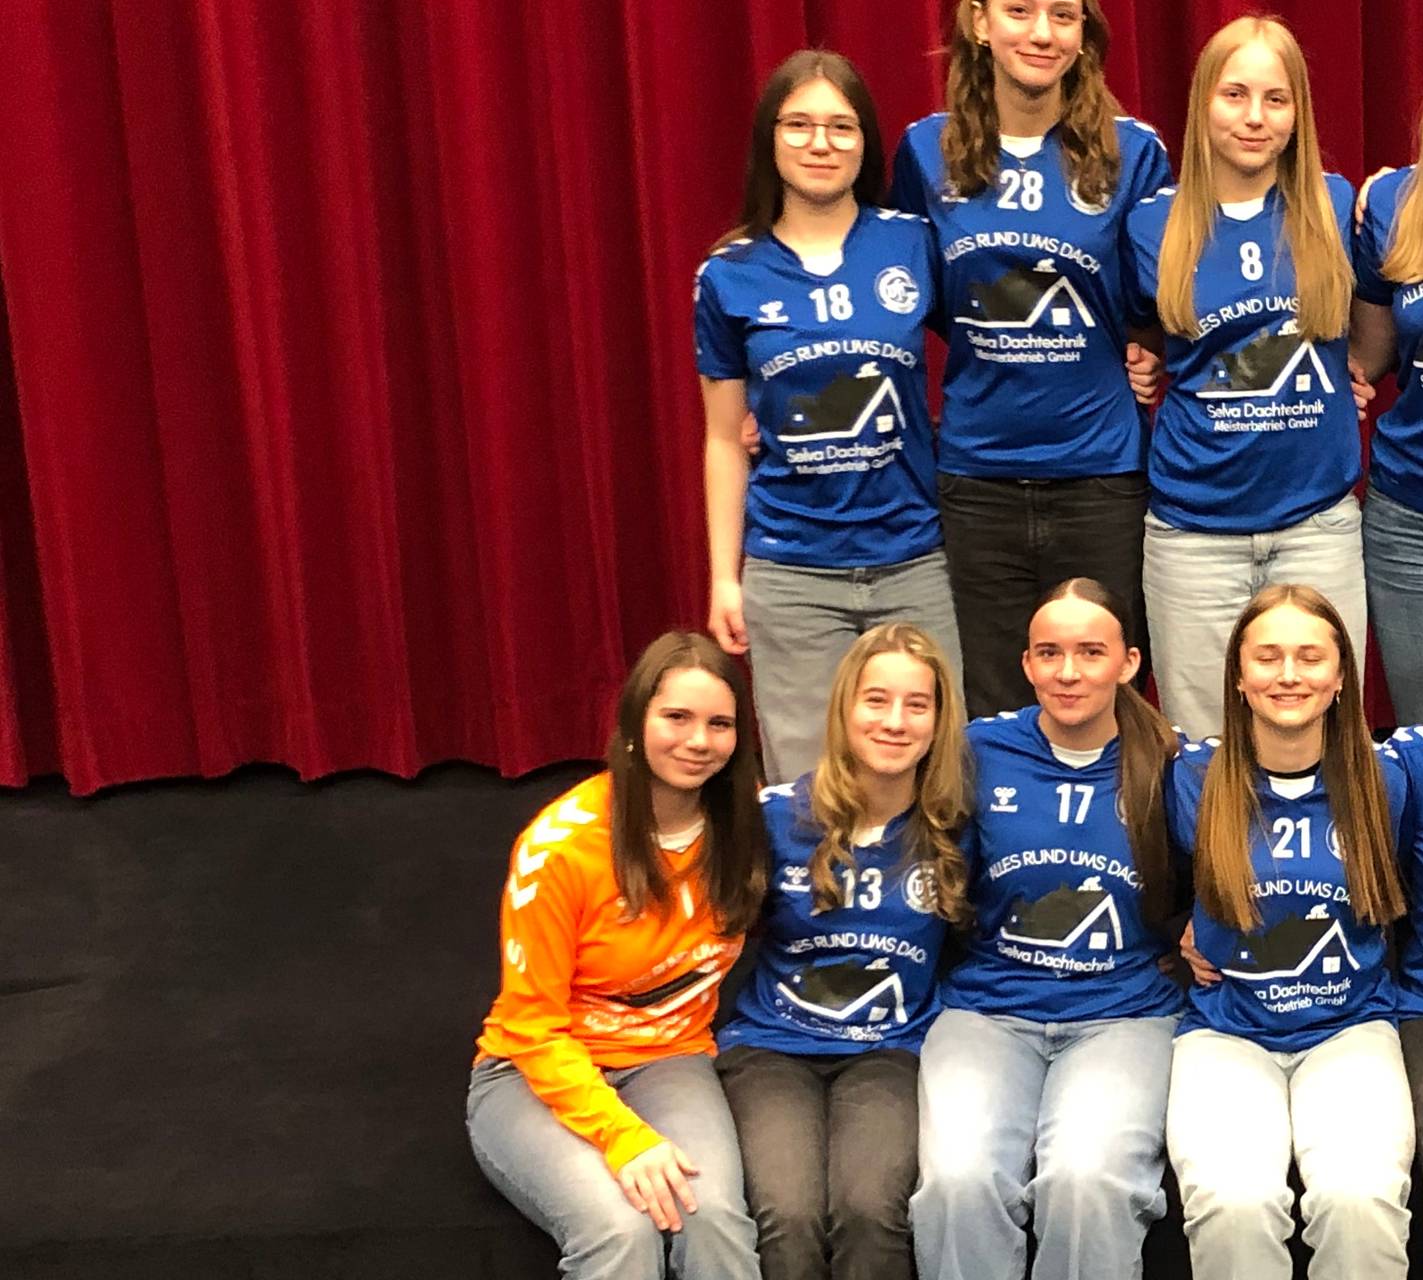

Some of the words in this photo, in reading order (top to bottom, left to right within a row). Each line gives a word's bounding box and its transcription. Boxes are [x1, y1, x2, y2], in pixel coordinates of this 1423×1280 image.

[997, 169, 1044, 211] 28
[976, 231, 1021, 248] RUND
[1023, 231, 1060, 253] UMS
[1058, 241, 1101, 275] DACH
[1239, 241, 1264, 281] 8
[808, 283, 854, 323] 18
[1219, 297, 1264, 321] RUND
[1265, 296, 1300, 313] UMS
[797, 341, 841, 362] RUND
[843, 338, 880, 357] UMS
[999, 332, 1087, 349] Dachtechnik
[1047, 351, 1080, 362] GmbH
[1206, 401, 1241, 418] Selva
[1243, 398, 1325, 418] Dachtechnik
[1213, 418, 1286, 432] Meisterbetrieb
[1288, 417, 1318, 430] GmbH
[1056, 783, 1095, 825] 17
[1272, 817, 1311, 858] 21
[1022, 849, 1067, 867] RUND
[1069, 849, 1107, 872] UMS
[841, 868, 883, 910] 13
[1248, 879, 1293, 898] RUND
[1295, 879, 1333, 899] UMS
[814, 932, 858, 949] RUND
[860, 932, 897, 953] UMS
[997, 941, 1032, 962] Selva
[1033, 950, 1116, 972] Dachtechnik
[1269, 977, 1352, 1000] Dachtechnik
[1315, 994, 1347, 1006] GmbH
